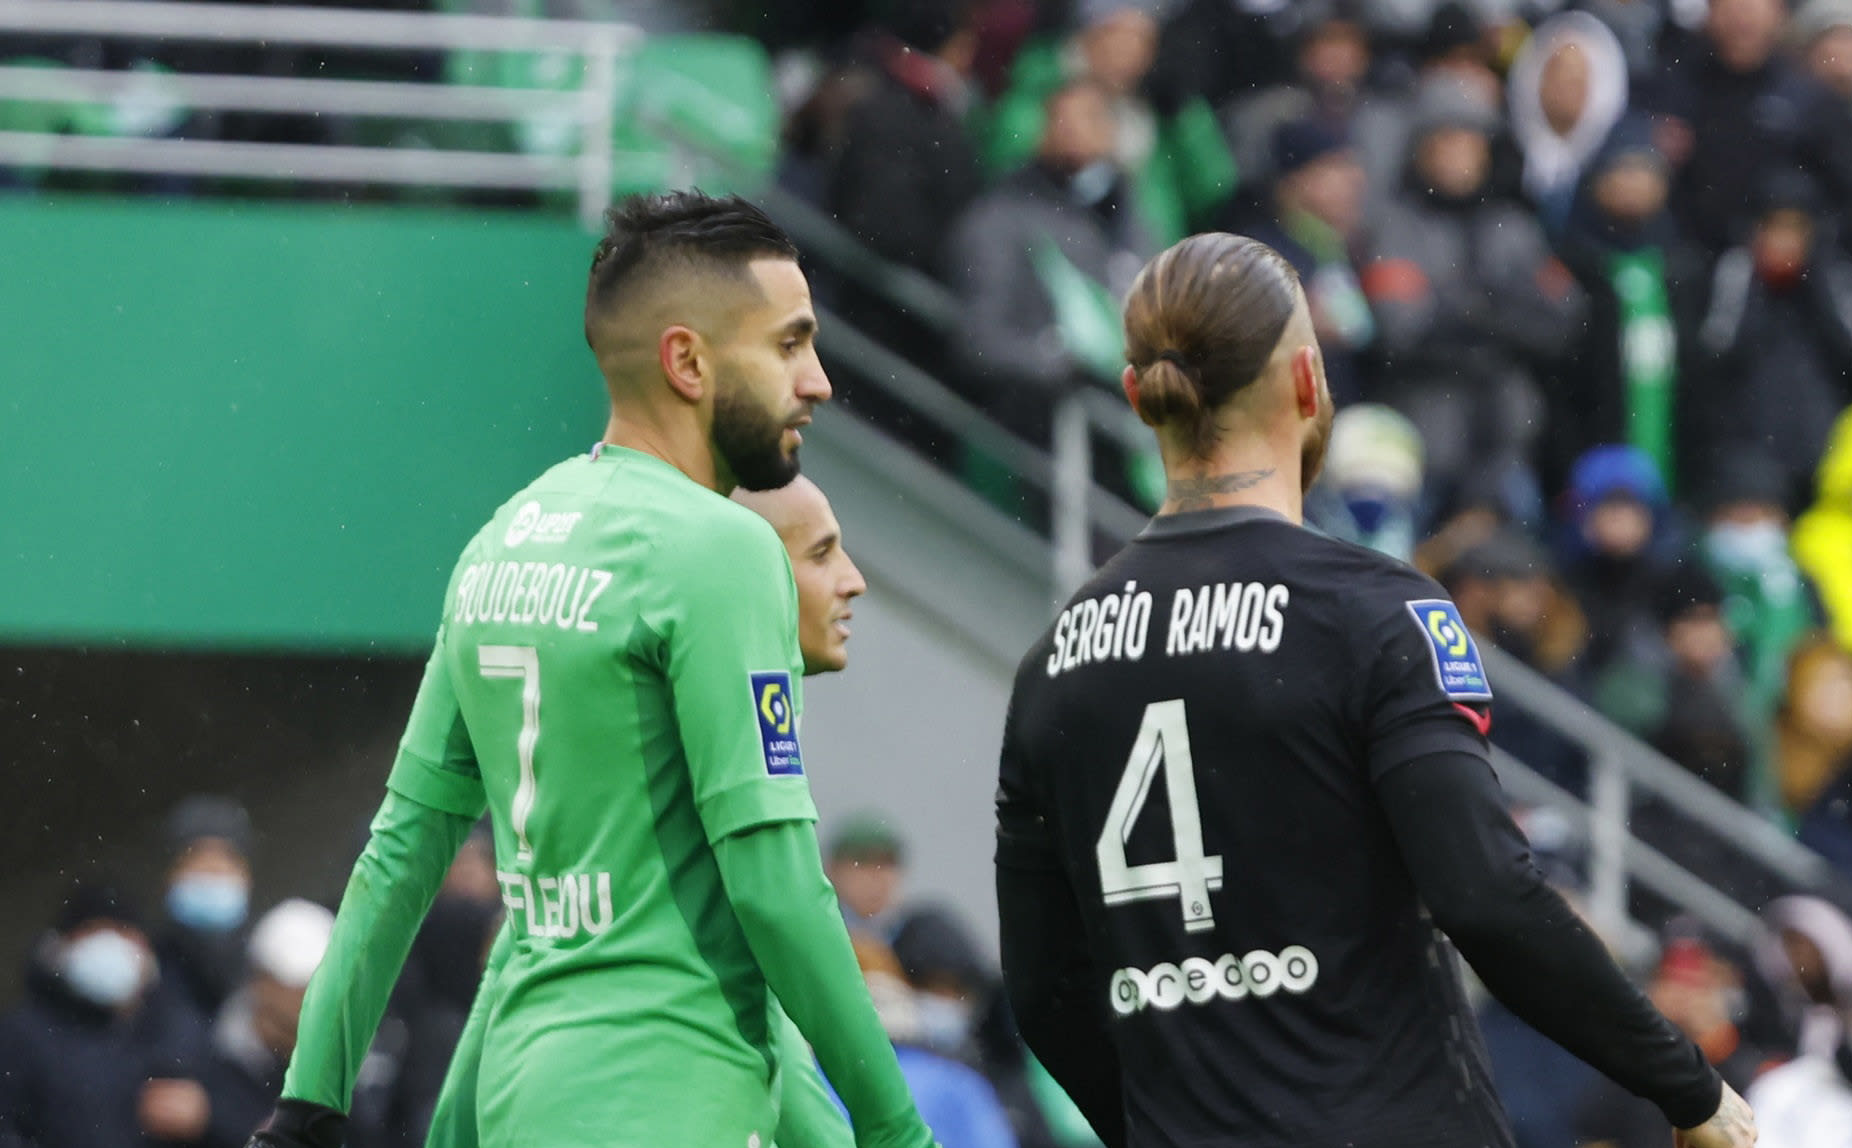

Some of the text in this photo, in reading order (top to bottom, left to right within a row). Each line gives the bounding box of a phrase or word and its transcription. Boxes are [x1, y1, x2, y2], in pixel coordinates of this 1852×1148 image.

[453, 560, 613, 633] BOUDEBOUZ
[1165, 581, 1290, 656] RAMOS
[477, 645, 540, 861] 7
[1097, 698, 1224, 932] 4
